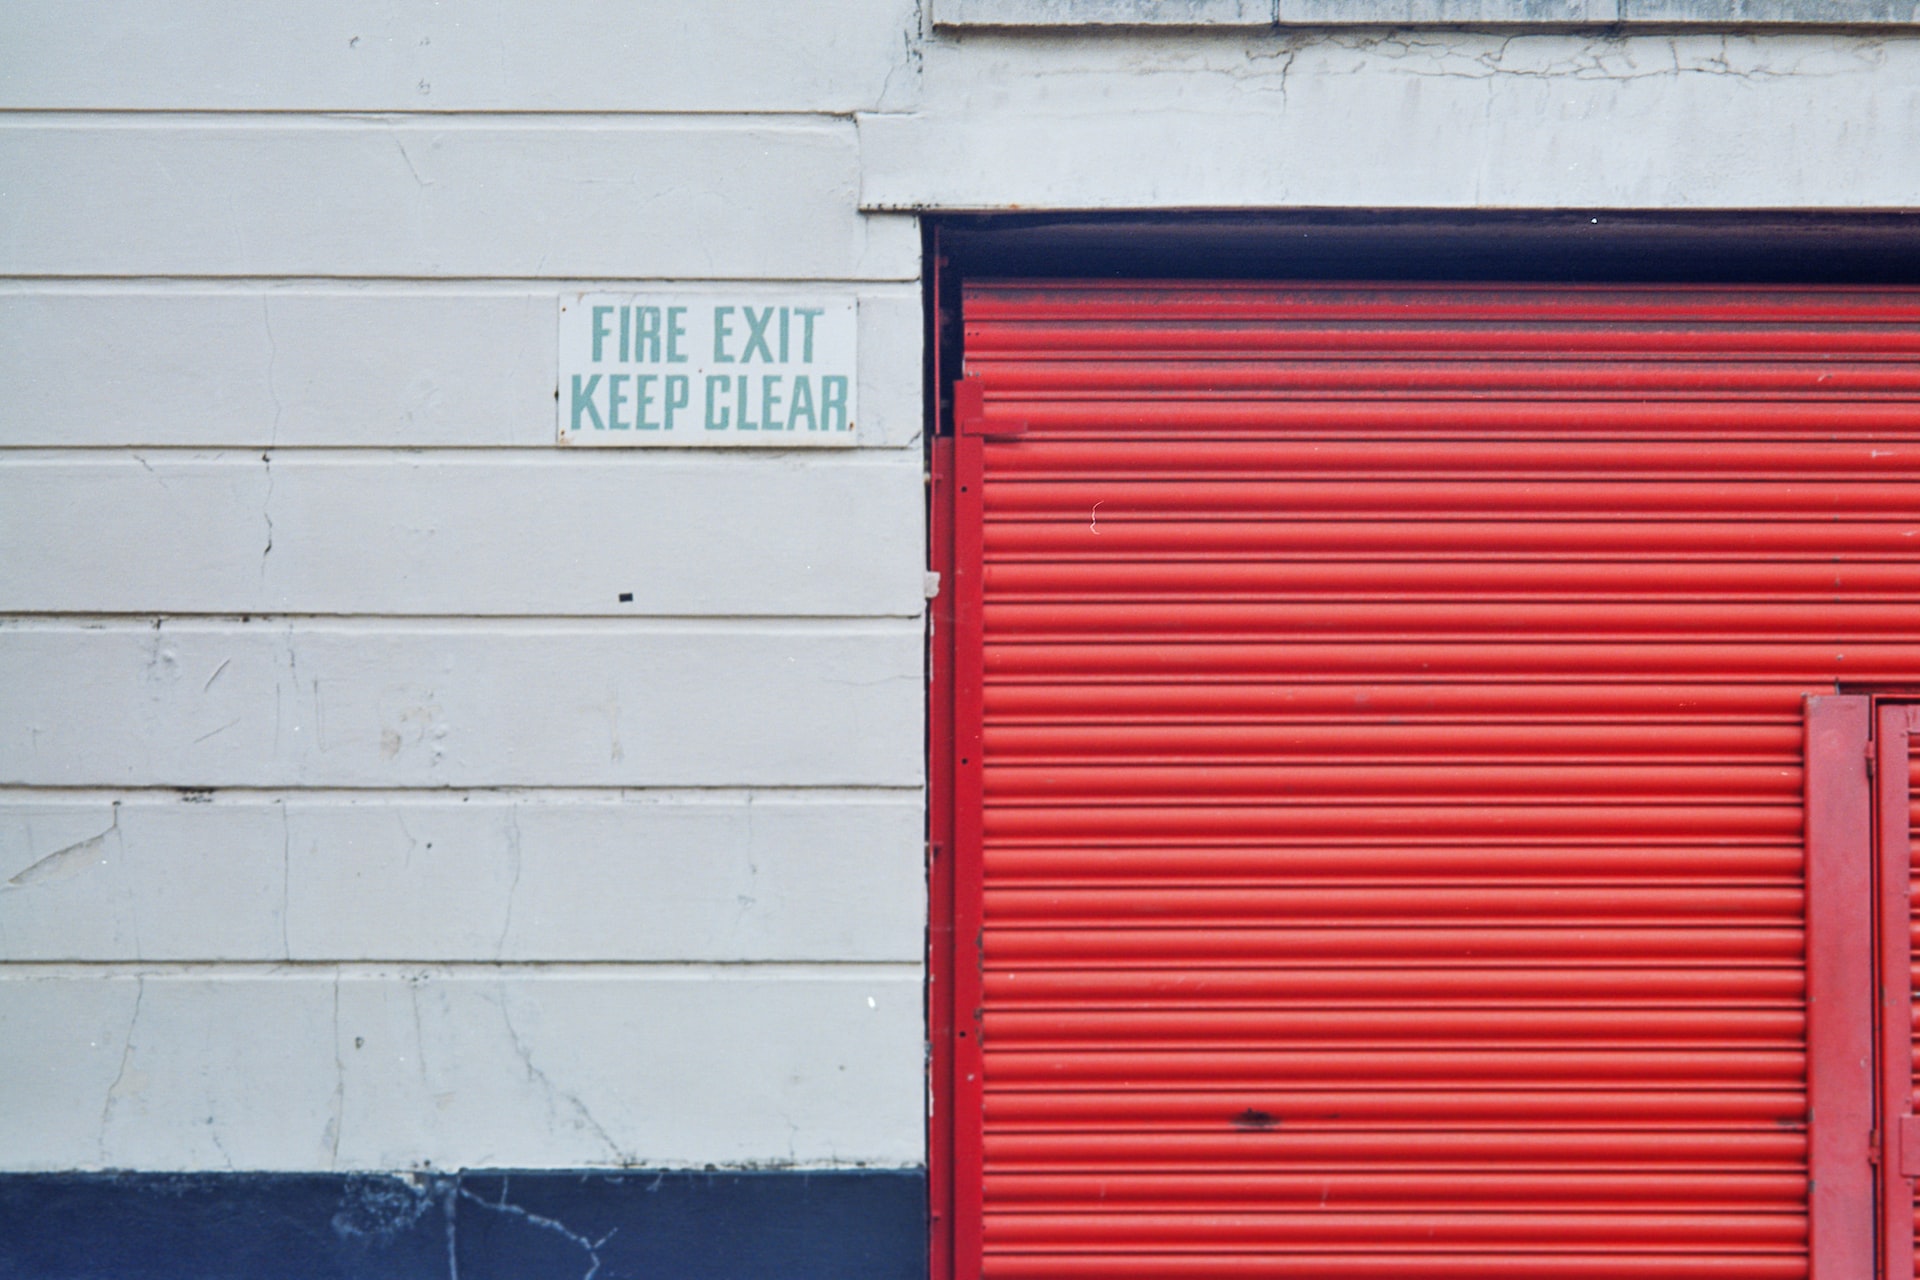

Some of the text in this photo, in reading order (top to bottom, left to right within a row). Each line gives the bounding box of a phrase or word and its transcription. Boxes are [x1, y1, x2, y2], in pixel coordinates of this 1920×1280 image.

[591, 305, 824, 364] FIRE EXIT
[570, 374, 848, 432] KEEP CLEAR
